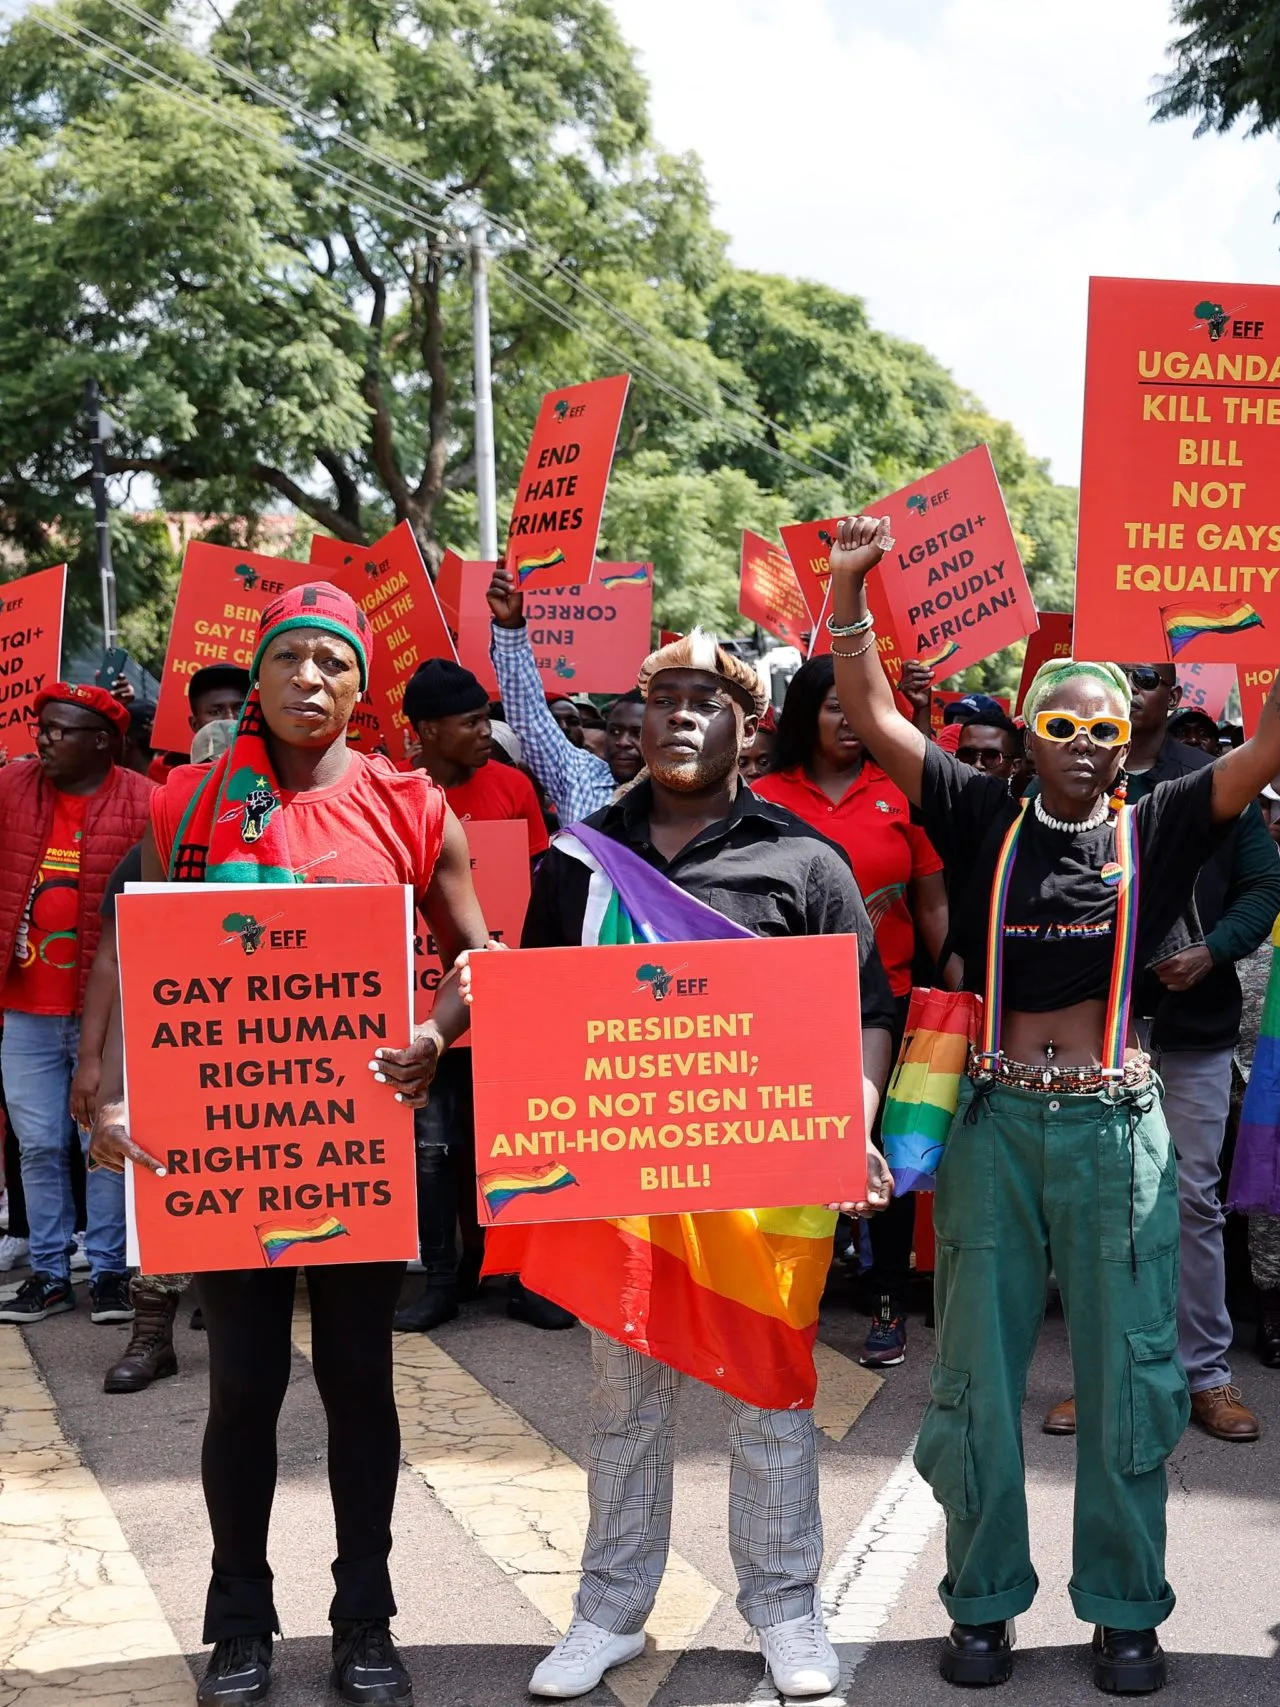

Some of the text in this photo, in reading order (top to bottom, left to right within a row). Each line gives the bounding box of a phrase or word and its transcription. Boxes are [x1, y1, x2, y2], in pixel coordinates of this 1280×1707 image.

[1233, 321, 1264, 337] EFF
[569, 405, 586, 418] EFF
[1143, 395, 1211, 422] KILL
[537, 443, 580, 469] END
[1178, 439, 1242, 466] BILL
[524, 475, 578, 503] HATE
[930, 489, 950, 507] EFF
[1172, 482, 1246, 508] NOT
[508, 507, 584, 538] CRIMES
[898, 514, 986, 570] LGBTQI+
[1124, 523, 1184, 549] THE
[927, 550, 974, 587] AND
[261, 580, 284, 594] EFF
[908, 560, 1005, 626] PROUDLY
[7, 598, 23, 612] EFF
[224, 604, 263, 623] BEIN
[302, 606, 349, 625] FREEDOM
[370, 610, 392, 634] KILL
[391, 593, 414, 620] THE
[525, 605, 616, 621] CORRECT
[194, 620, 236, 639] GAY
[240, 629, 255, 643] IS
[917, 587, 1017, 653] AFRICAN!
[1, 627, 43, 652] TQI+
[194, 641, 228, 660] THE
[386, 625, 411, 651] BILL
[531, 630, 574, 645] END
[875, 636, 894, 653] AYS
[0, 657, 23, 676] ND
[393, 645, 419, 674] NOT
[0, 673, 45, 704] UDLY
[270, 930, 306, 947] EFF
[1003, 924, 1039, 937] HEY
[152, 976, 233, 1006] GAY
[248, 971, 381, 1002] RIGHTS
[677, 978, 708, 994] EFF
[151, 1013, 386, 1048] ARE HUMAN
[587, 1013, 754, 1043] PRESIDENT
[200, 1058, 345, 1089] RIGHTS,
[584, 1051, 759, 1081] MUSEVENI;
[206, 1099, 355, 1130] HUMAN
[528, 1084, 812, 1122] DO NOT SIGN THE
[490, 1115, 851, 1158] ANTI-HOMOSEXUALITY
[167, 1139, 385, 1174] RIGHTS ARE
[640, 1164, 711, 1190] BILL!
[164, 1180, 392, 1217] GAY RIGHTS
